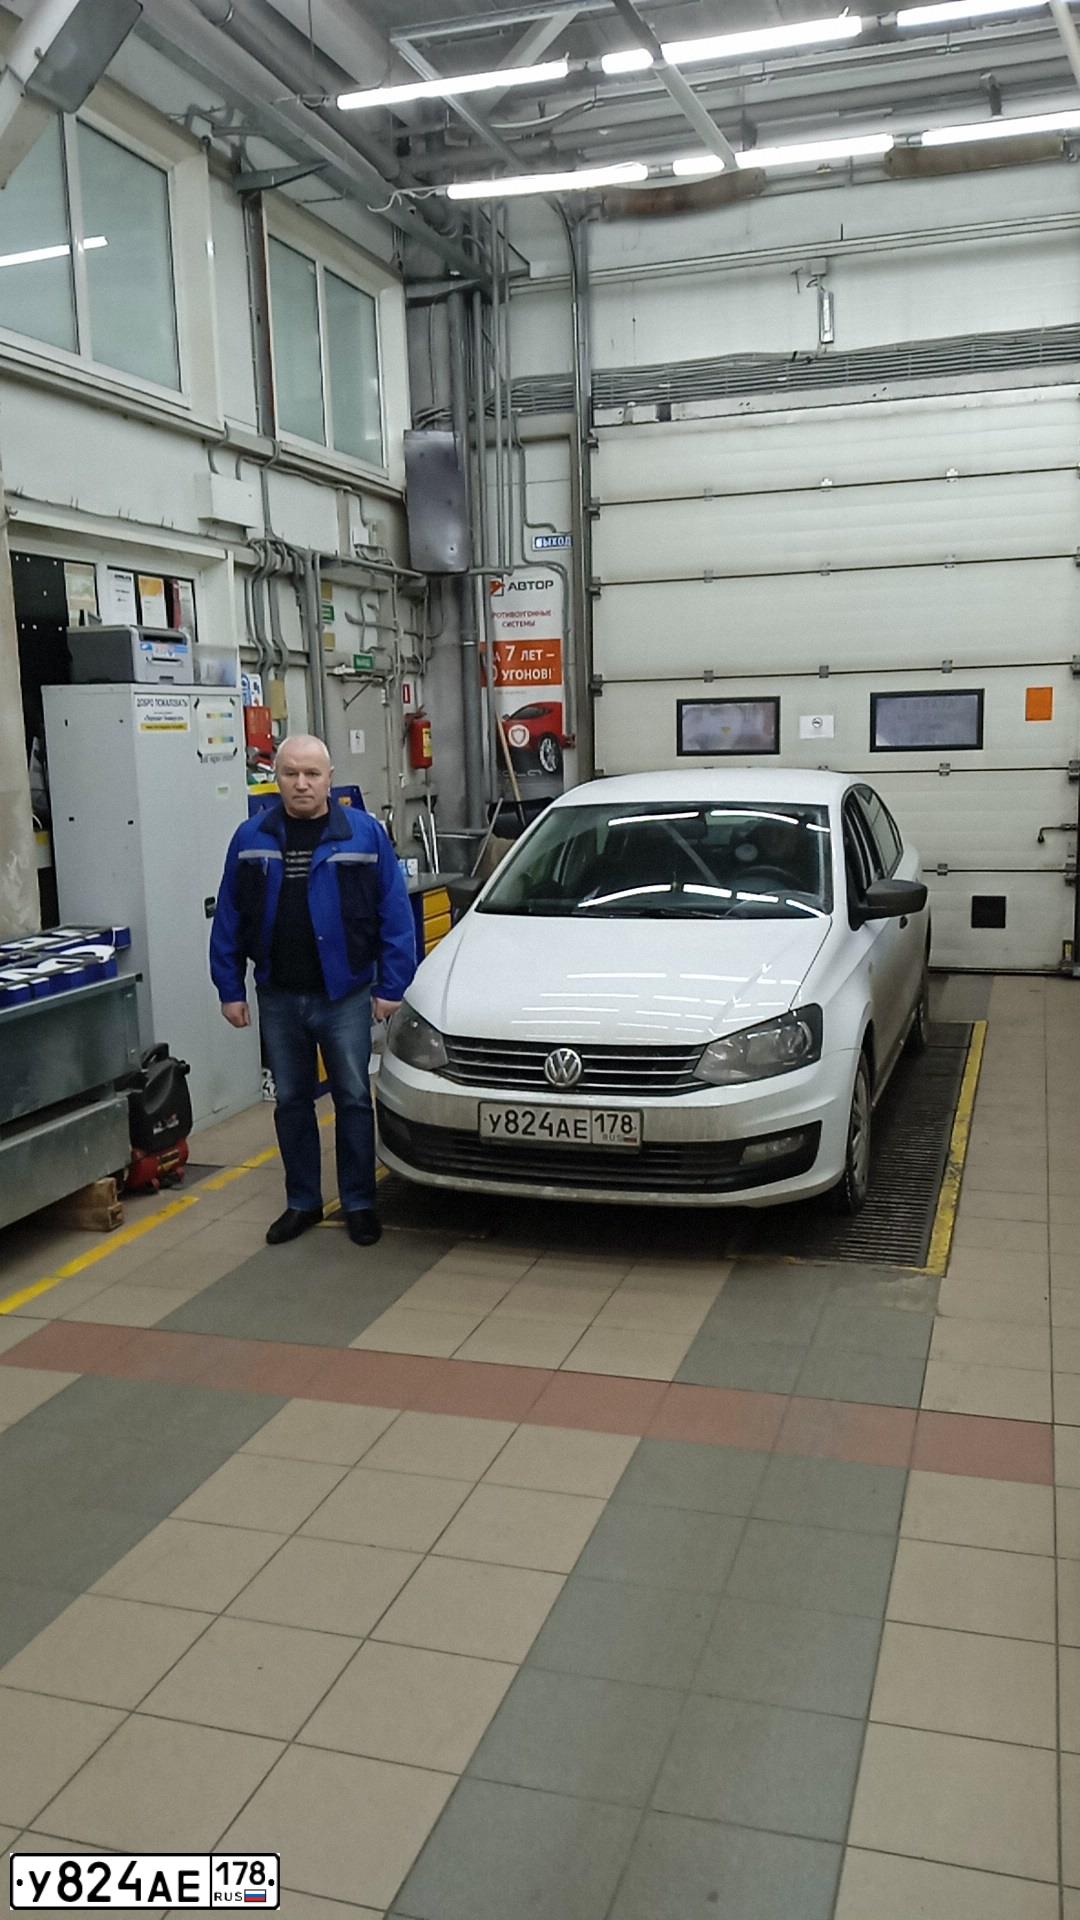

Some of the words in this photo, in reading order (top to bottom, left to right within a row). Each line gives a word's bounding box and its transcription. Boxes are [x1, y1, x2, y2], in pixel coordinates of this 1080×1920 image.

[508, 580, 554, 591] АВТОР
[491, 609, 552, 620] РОТИВОУГОННЫЕ
[505, 645, 516, 661] 7
[520, 649, 544, 661] ЛЕТ
[501, 668, 552, 680] УГОНОВ!
[489, 1109, 588, 1139] У824АЕ
[594, 1113, 633, 1134] 178
